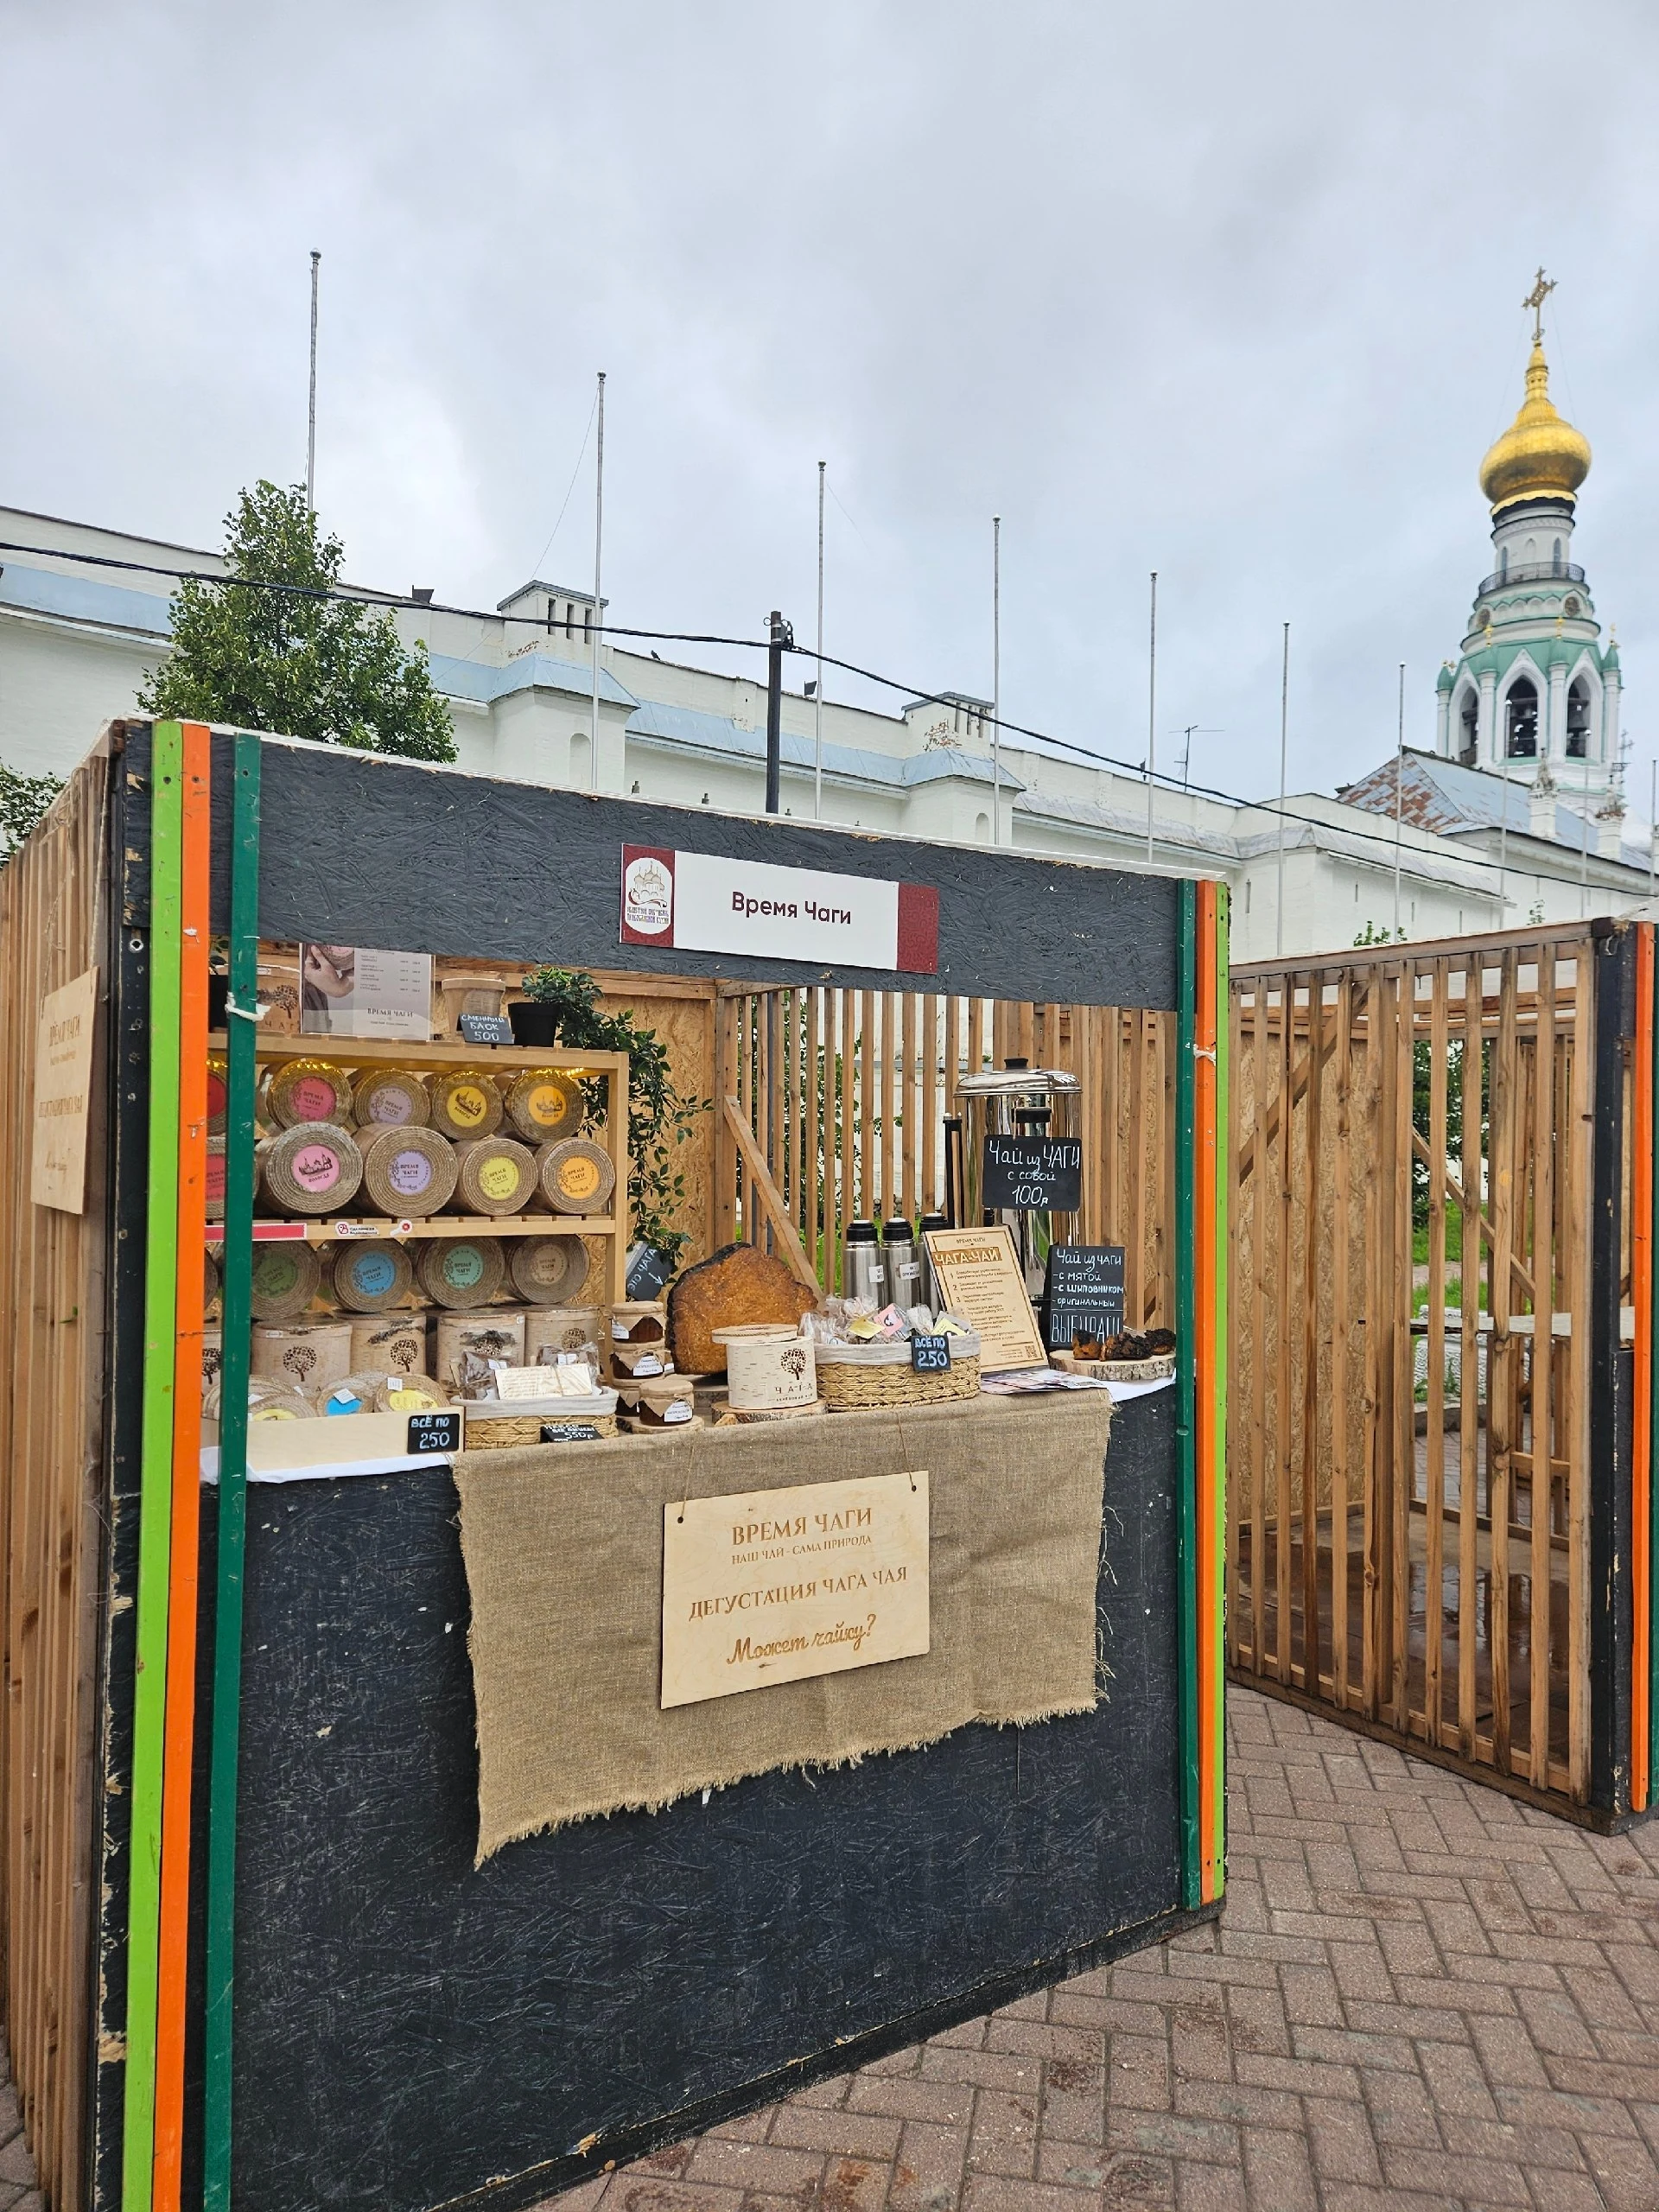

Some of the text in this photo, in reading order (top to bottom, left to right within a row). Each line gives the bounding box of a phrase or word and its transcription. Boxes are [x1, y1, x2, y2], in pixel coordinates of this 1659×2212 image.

[732, 891, 852, 925] Время Чаги
[367, 1007, 391, 1016] ВРЕМЯ
[474, 1031, 499, 1040] 500
[989, 1140, 1080, 1172] Чай из ЧАГИ
[1007, 1170, 1056, 1181] с собой
[935, 1247, 999, 1265] ЧАГА-ЧАЙ
[1056, 1248, 1122, 1273] Чай из ЧАГИ
[627, 1249, 658, 1291] ЭТО ЧАГА
[915, 1335, 946, 1349] ВСЁ ПО
[918, 1351, 948, 1368] 250
[410, 1414, 450, 1428] ВСЁ ПО
[419, 1432, 450, 1449] 250
[732, 1508, 872, 1546] ВРЕМЯ ЧАГИ
[732, 1552, 759, 1565] НАШ
[761, 1546, 785, 1560] ЧАЙ
[792, 1543, 822, 1555] САМА
[823, 1535, 872, 1550] ПРИРОДА
[689, 1567, 907, 1622] ДЕГУСТАЦИЯ ЧАГА ЧАЯ
[726, 1613, 877, 1665] Может чайку?
